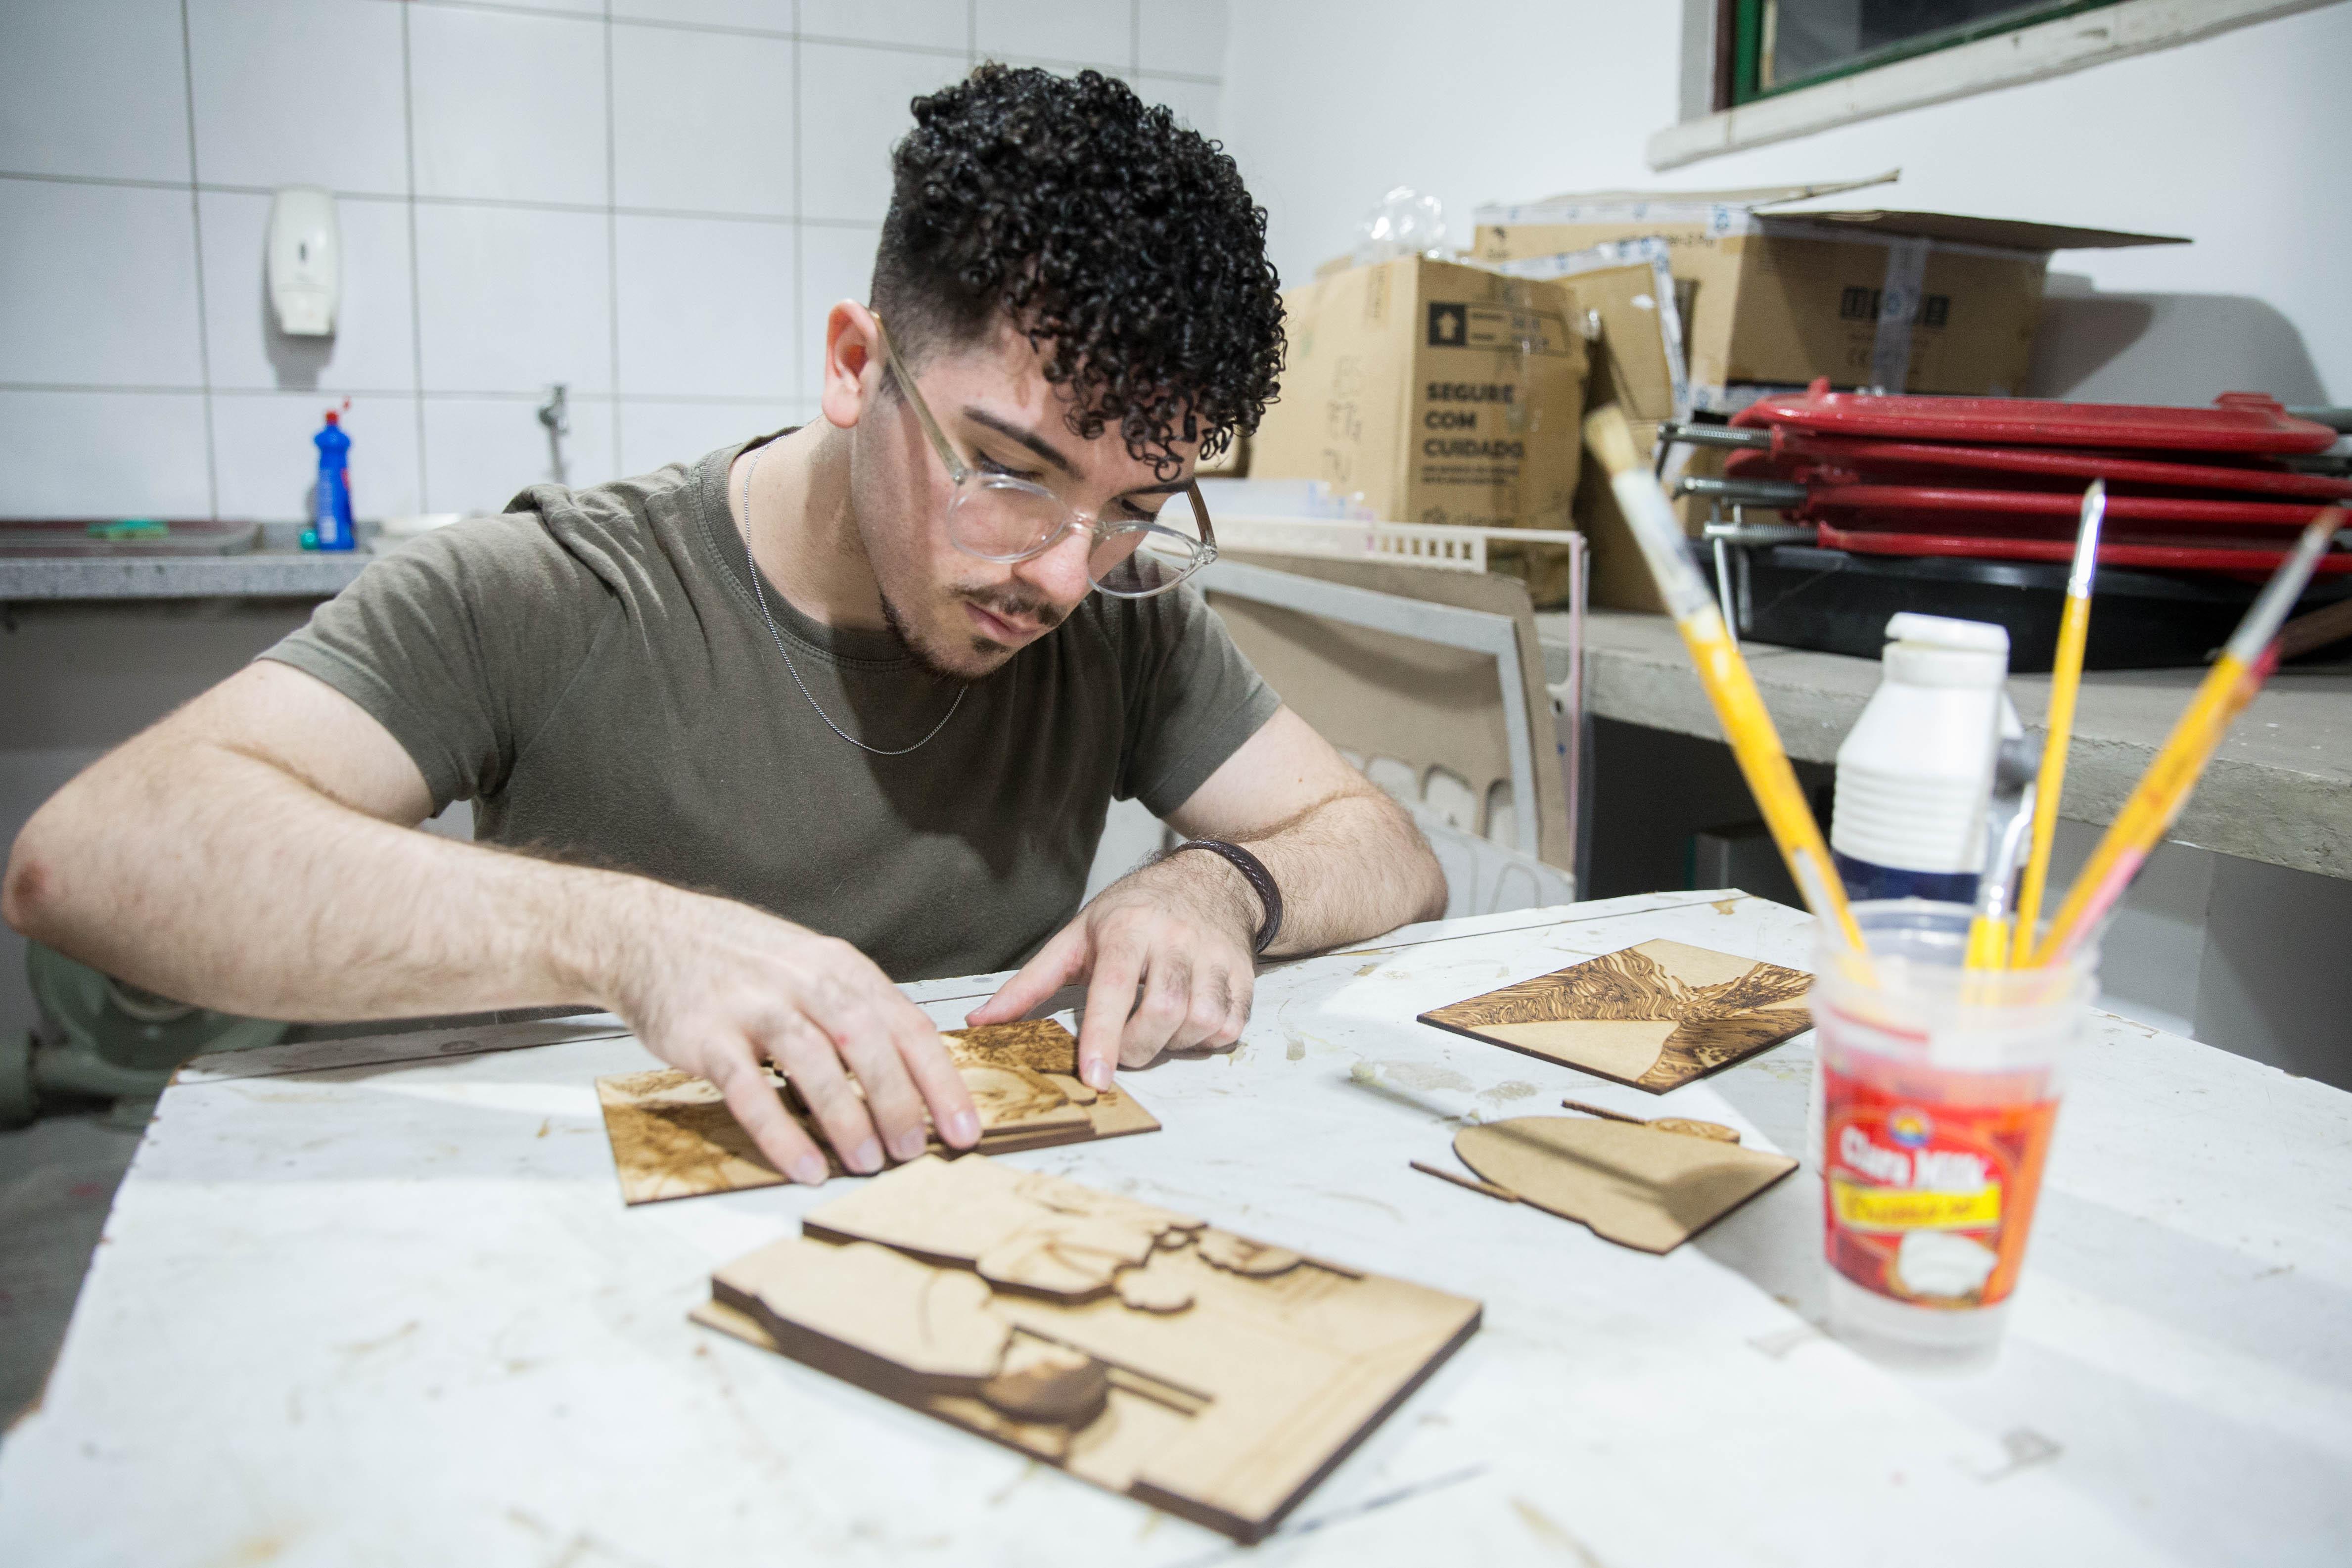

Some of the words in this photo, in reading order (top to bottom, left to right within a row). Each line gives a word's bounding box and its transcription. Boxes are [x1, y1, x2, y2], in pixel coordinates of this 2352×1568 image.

[1427, 382, 1514, 404] SEGURE
[1425, 411, 1476, 429] COM
[1424, 439, 1524, 459] CUIDADO
